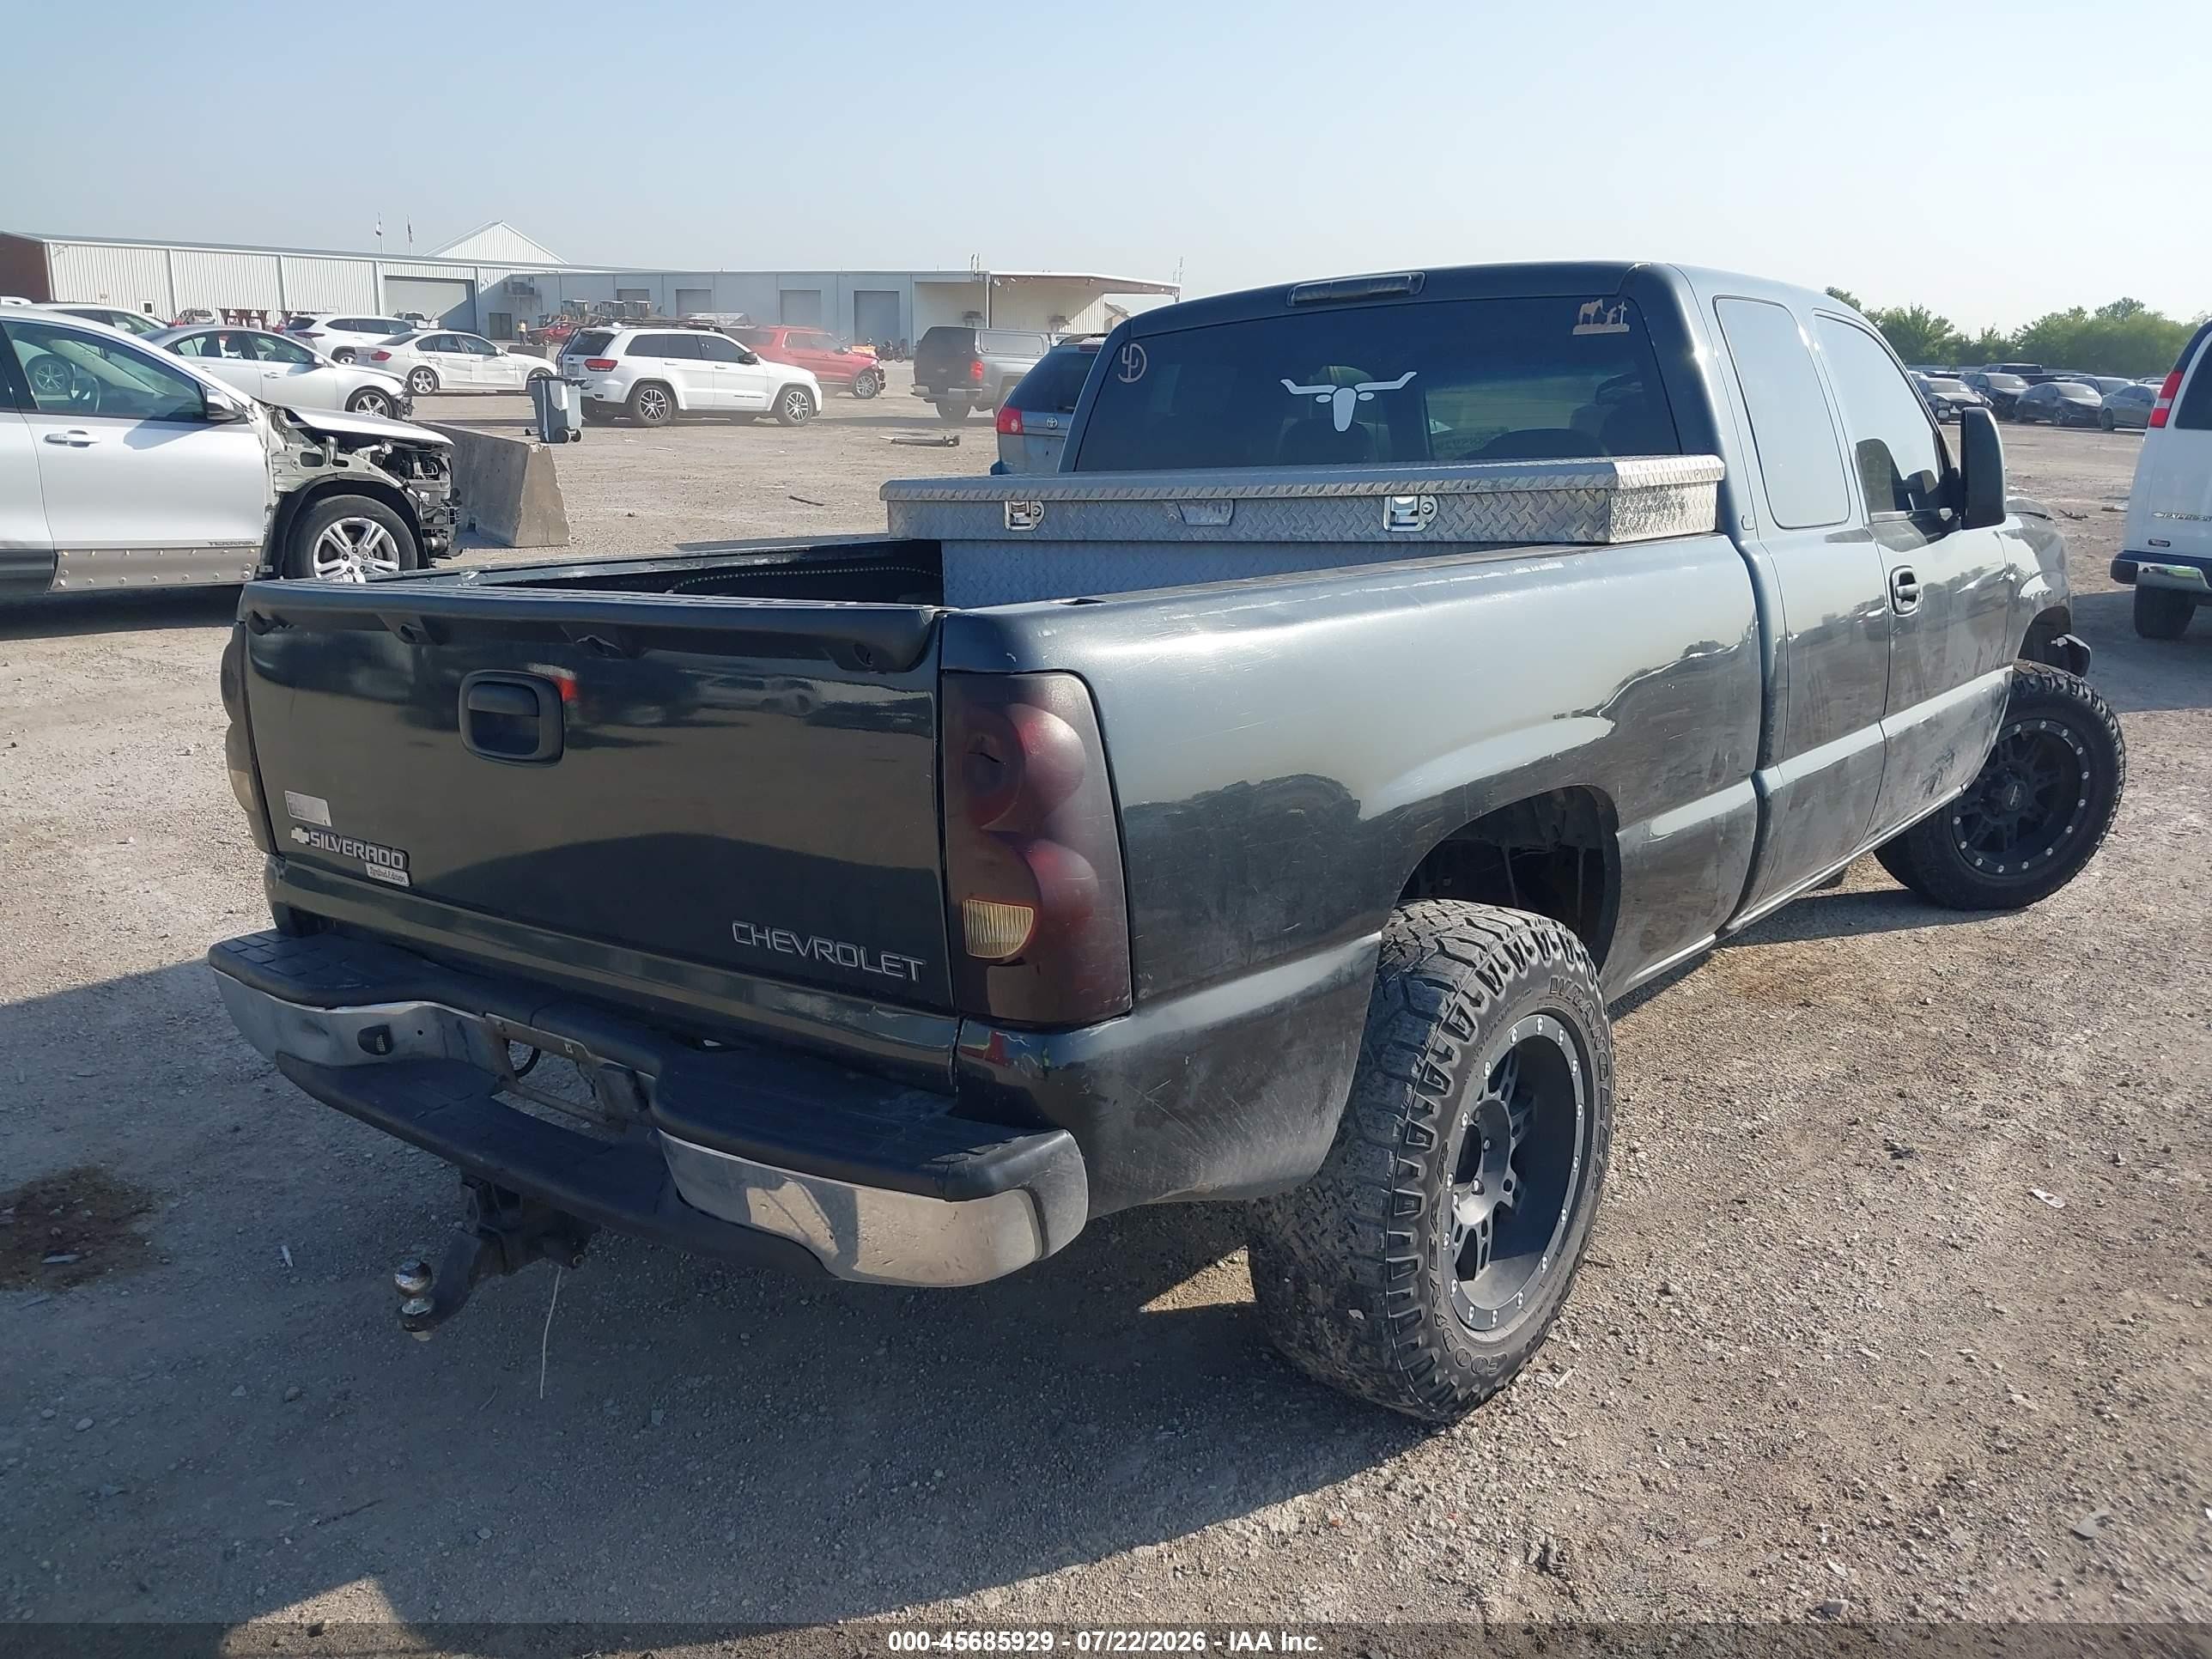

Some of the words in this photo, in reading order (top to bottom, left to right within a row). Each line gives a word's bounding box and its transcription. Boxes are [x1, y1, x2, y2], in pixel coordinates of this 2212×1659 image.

[310, 832, 404, 870] SILVERADO
[732, 921, 926, 981] CHEVROLET
[1548, 976, 1610, 1194] WRANGLER
